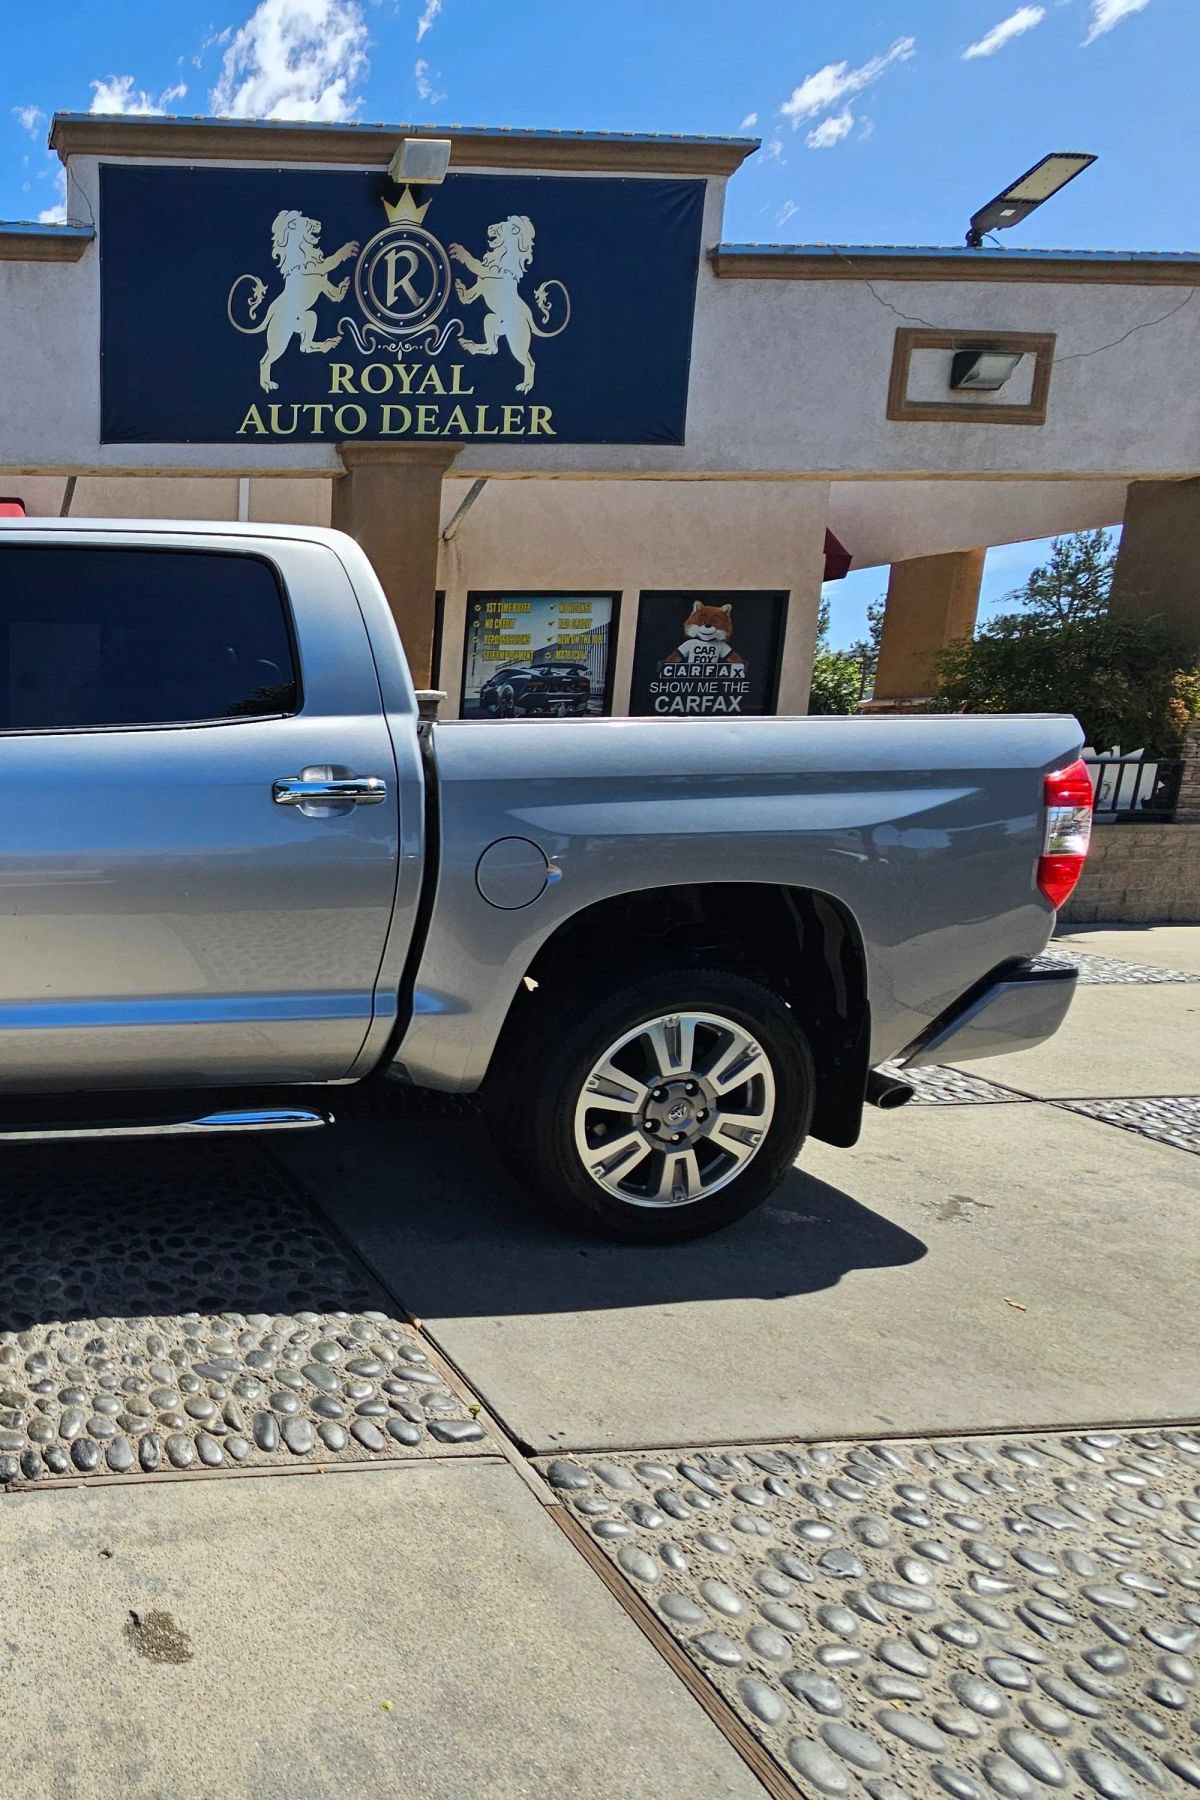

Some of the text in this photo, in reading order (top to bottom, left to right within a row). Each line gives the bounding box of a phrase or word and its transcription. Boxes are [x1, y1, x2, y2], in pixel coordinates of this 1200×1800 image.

[328, 363, 474, 395] ROYAL
[236, 404, 557, 435] AUTO DEALER
[693, 646, 716, 655] CAR
[693, 655, 714, 664] FOX
[663, 665, 744, 678] CARFAX
[649, 681, 750, 693] SHOW ME THE
[654, 695, 743, 713] CARFAX
